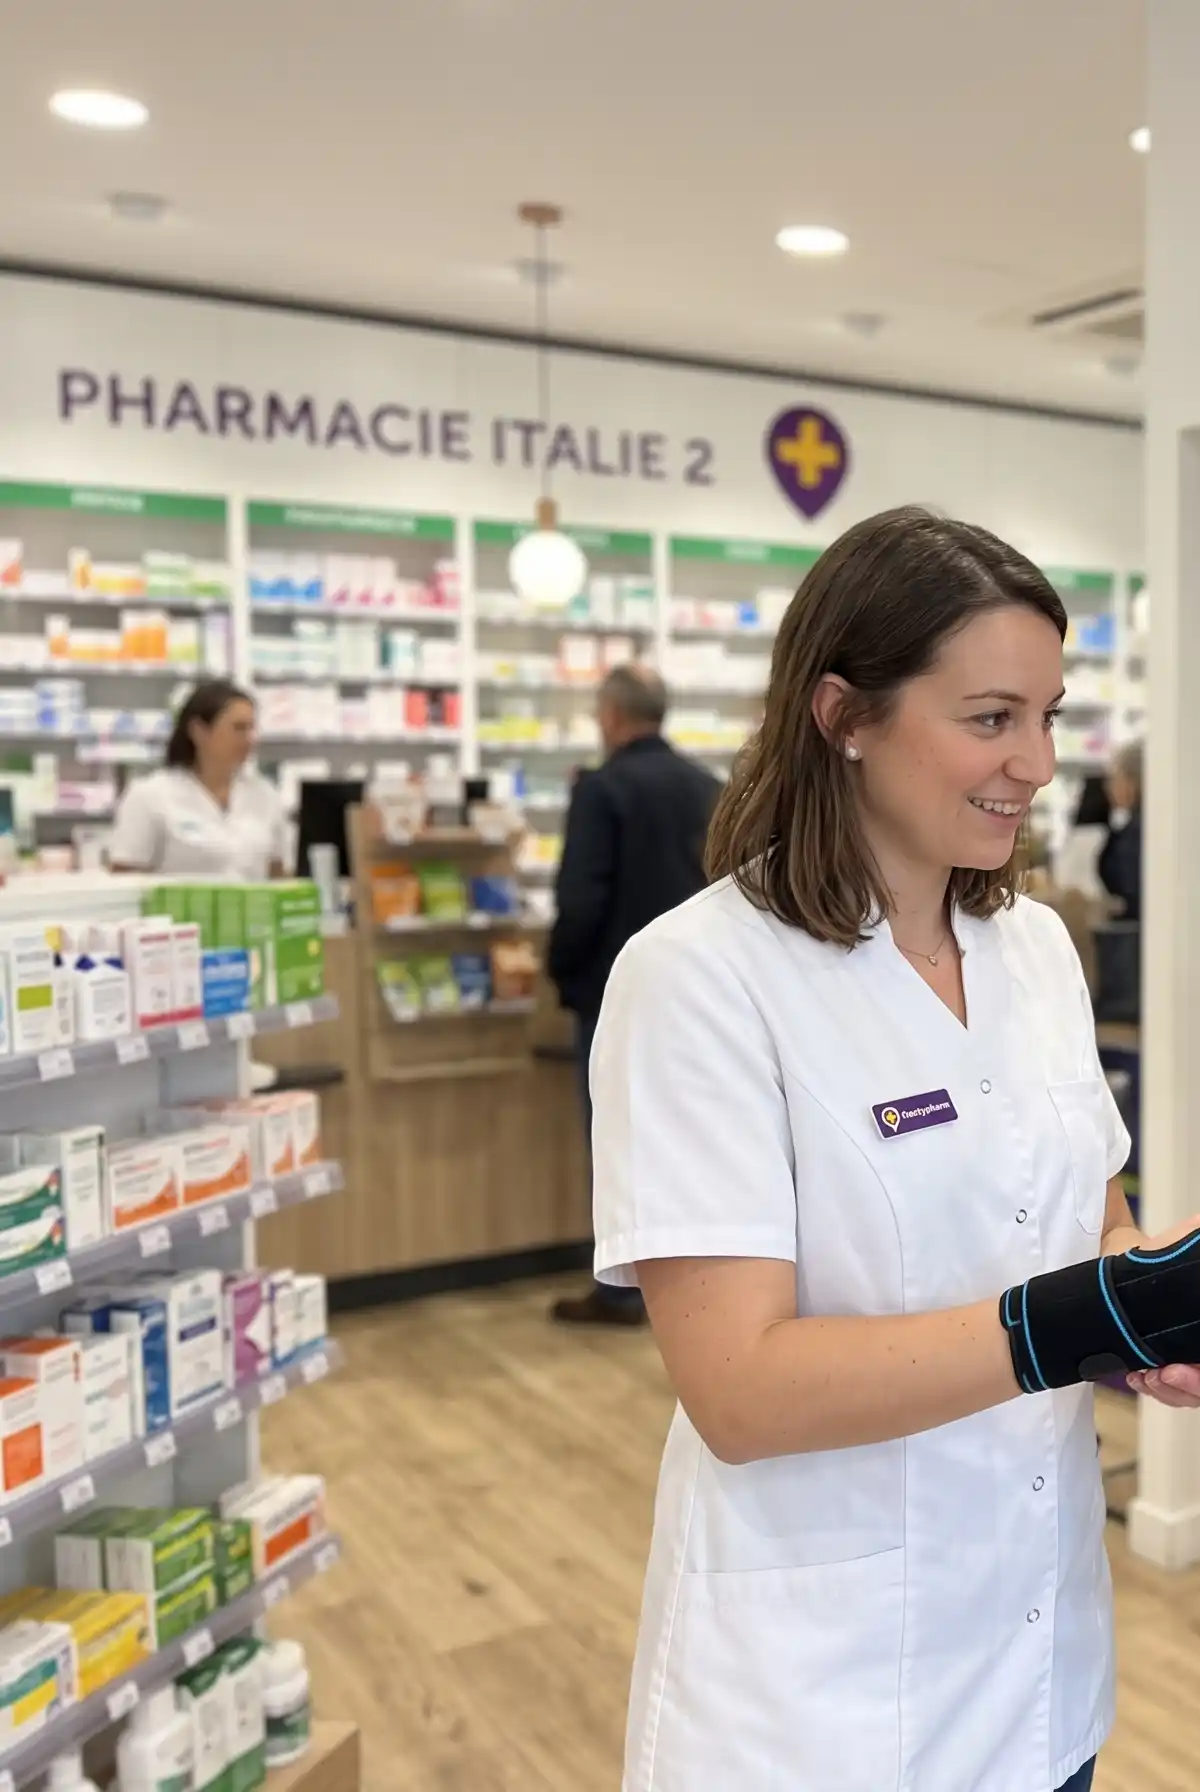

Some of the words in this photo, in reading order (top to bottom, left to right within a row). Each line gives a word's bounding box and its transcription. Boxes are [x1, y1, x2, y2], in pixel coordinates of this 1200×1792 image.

[57, 368, 473, 462] PHARMACIE
[490, 418, 667, 481] ITALIE
[682, 436, 717, 487] 2
